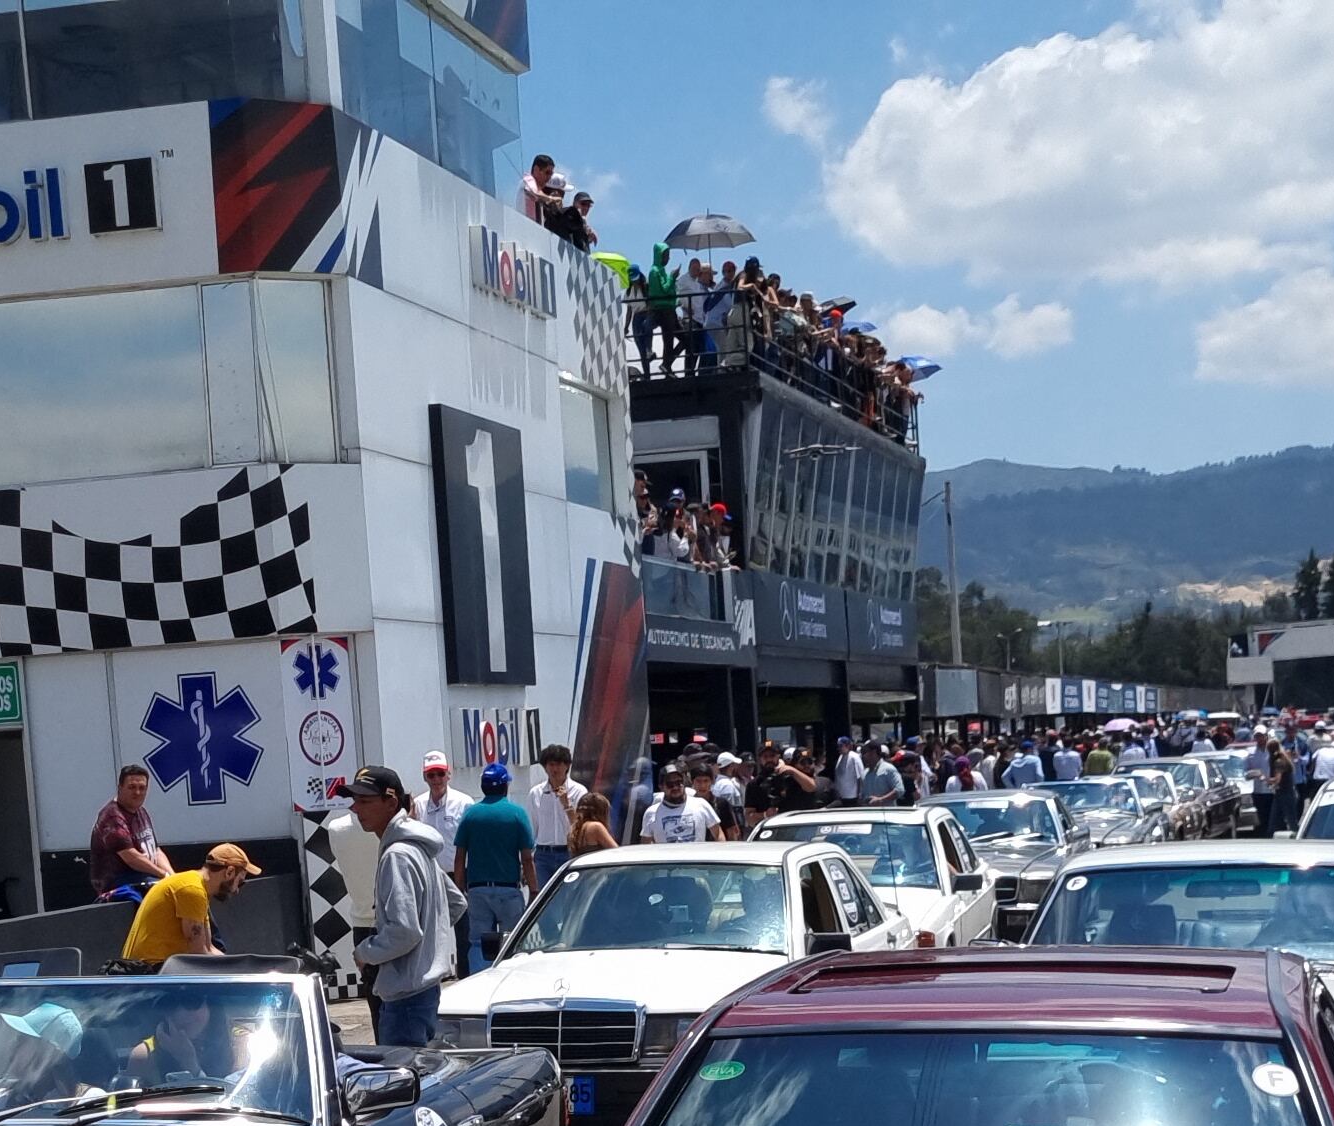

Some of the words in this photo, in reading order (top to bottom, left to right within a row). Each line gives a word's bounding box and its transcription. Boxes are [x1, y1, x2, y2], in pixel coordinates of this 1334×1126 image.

[481, 225, 538, 309] Mobil
[462, 708, 521, 767] Mobil
[569, 1083, 592, 1104] 85
[1267, 1070, 1284, 1088] F
